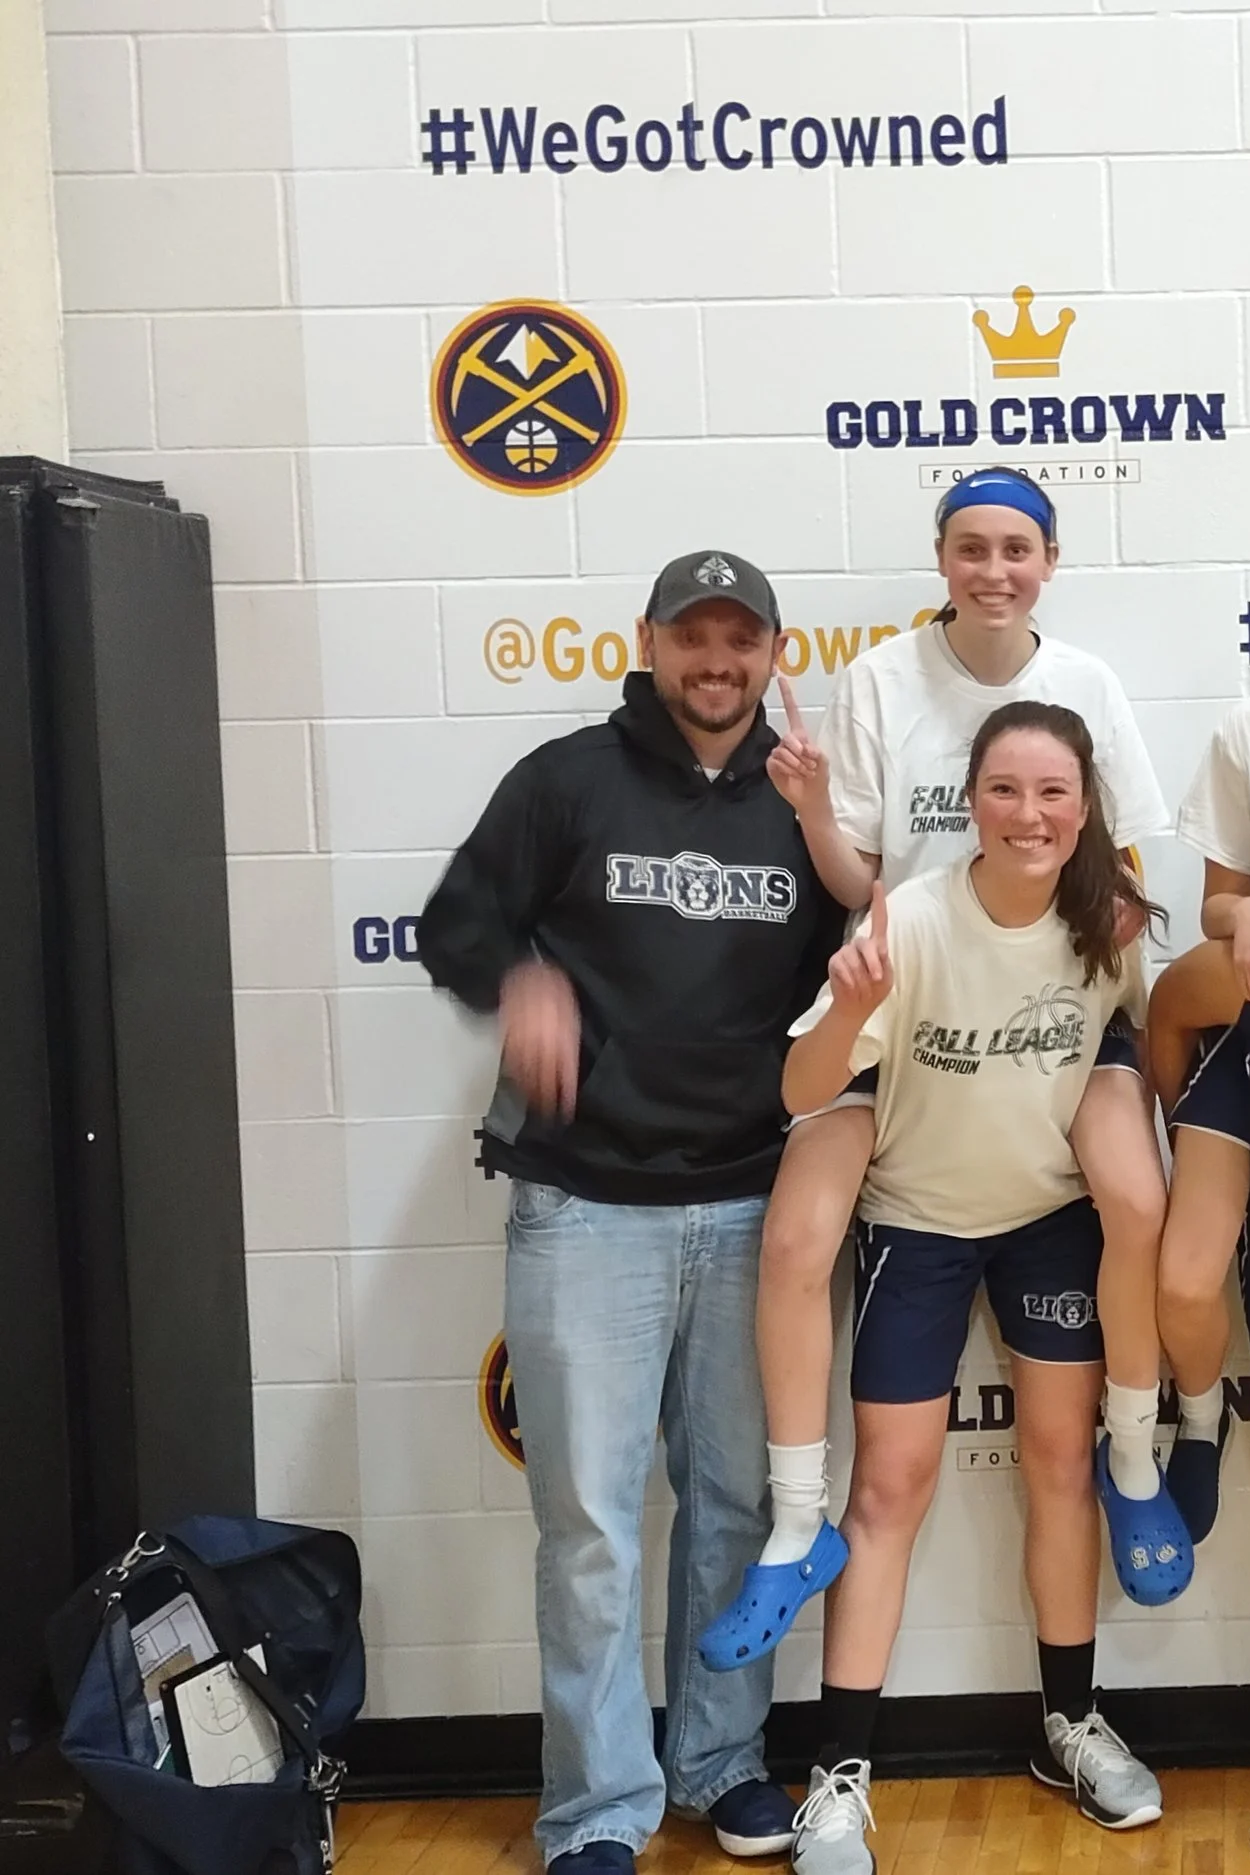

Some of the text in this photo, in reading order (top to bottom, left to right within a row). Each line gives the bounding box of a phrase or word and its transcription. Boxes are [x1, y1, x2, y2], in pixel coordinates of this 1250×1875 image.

[420, 95, 1009, 175] #WeGotCrowned
[826, 393, 1227, 449] GOLD CROWN
[932, 465, 1128, 483] FOATION
[606, 851, 797, 921] LIONS
[912, 1020, 981, 1057] FALL
[985, 1019, 1084, 1057] LEAGUE
[912, 1047, 981, 1076] CHAMPION
